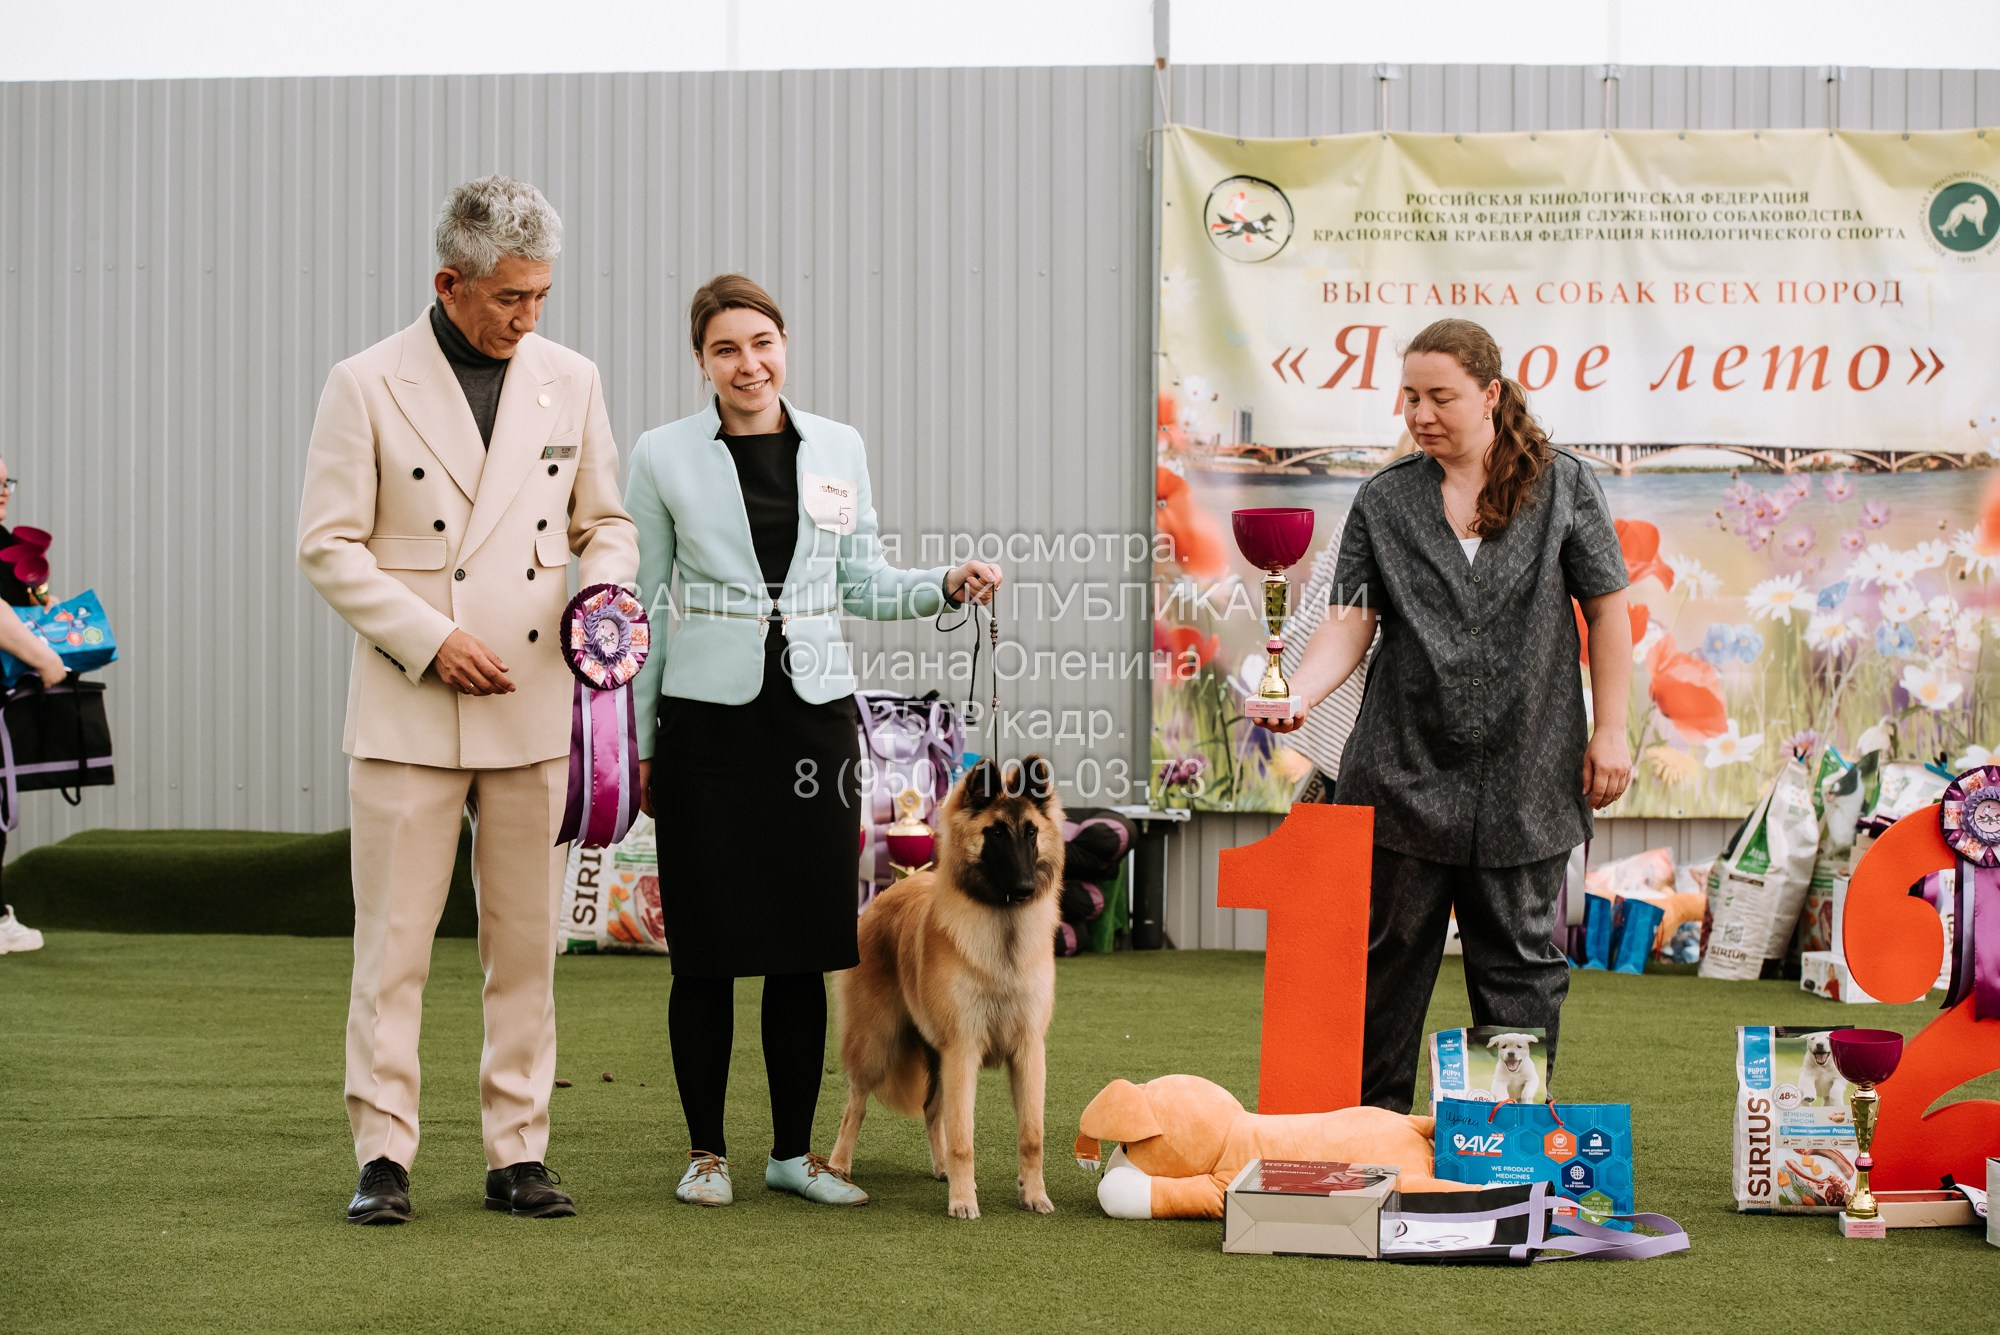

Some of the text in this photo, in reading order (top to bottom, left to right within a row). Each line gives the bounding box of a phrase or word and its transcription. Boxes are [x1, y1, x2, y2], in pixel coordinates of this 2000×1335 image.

[1406, 190, 1810, 207] РОССИЙСКАЯ КИНОЛОГИЧЕСКАЯ ФЕДЕРАЦИЯ
[1354, 208, 1864, 226] РОССИЙСКАЯ ФЕДЕРАЦИЯ СЛУЖЕБНОГО СОБАКОВОДСТВА
[1312, 227, 1906, 243] КРАСНОЯРСКАЯ КРАЕВАЯ ФЕДЕРАЦИЯ КИНОЛОГИЧЕСКОГО СПОРТА
[1321, 280, 1905, 309] ВЫСТАВКА СОБАК ВСЕХ ПОРОД
[1271, 325, 1946, 414] «Яое лето»
[839, 505, 852, 526] 5
[572, 843, 602, 926] SIRI
[1217, 802, 1375, 1114] 1
[1710, 945, 1747, 961] SIRIUS
[1442, 1069, 1461, 1078] PUPPY
[1747, 1067, 1767, 1075] PUPPY
[1778, 1092, 1797, 1101] 48%
[1460, 1135, 1505, 1153] AVZ
[1747, 1097, 1771, 1197] SIRIUS
